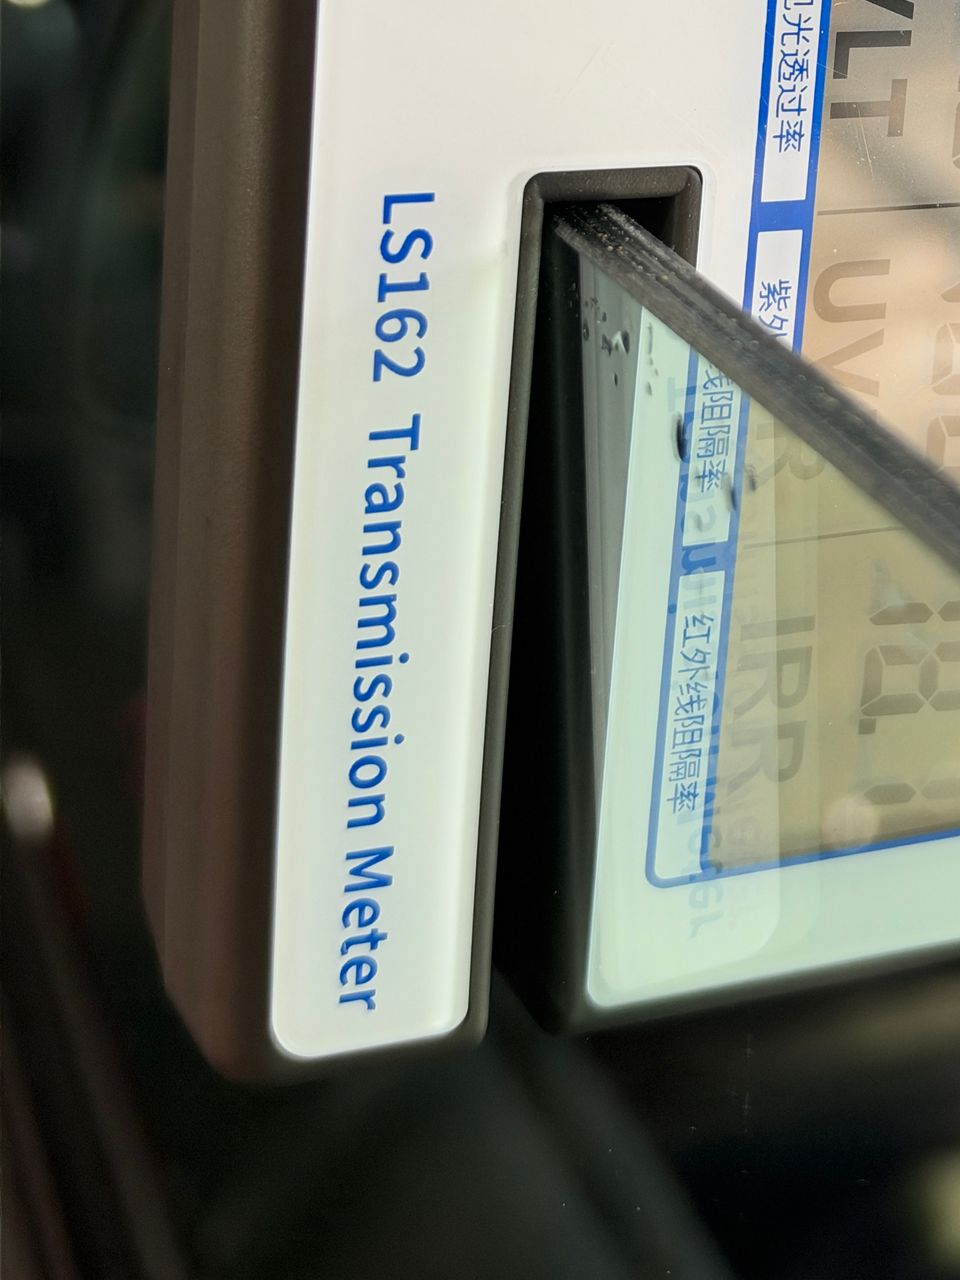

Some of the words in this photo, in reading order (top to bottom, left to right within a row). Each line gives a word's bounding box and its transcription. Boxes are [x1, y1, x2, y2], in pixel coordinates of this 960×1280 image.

[372, 192, 435, 382] LS162
[346, 414, 421, 830] Transmission
[665, 613, 716, 816] 红外线阻隔率
[725, 614, 816, 794] IRR
[338, 846, 395, 1012] Meter
